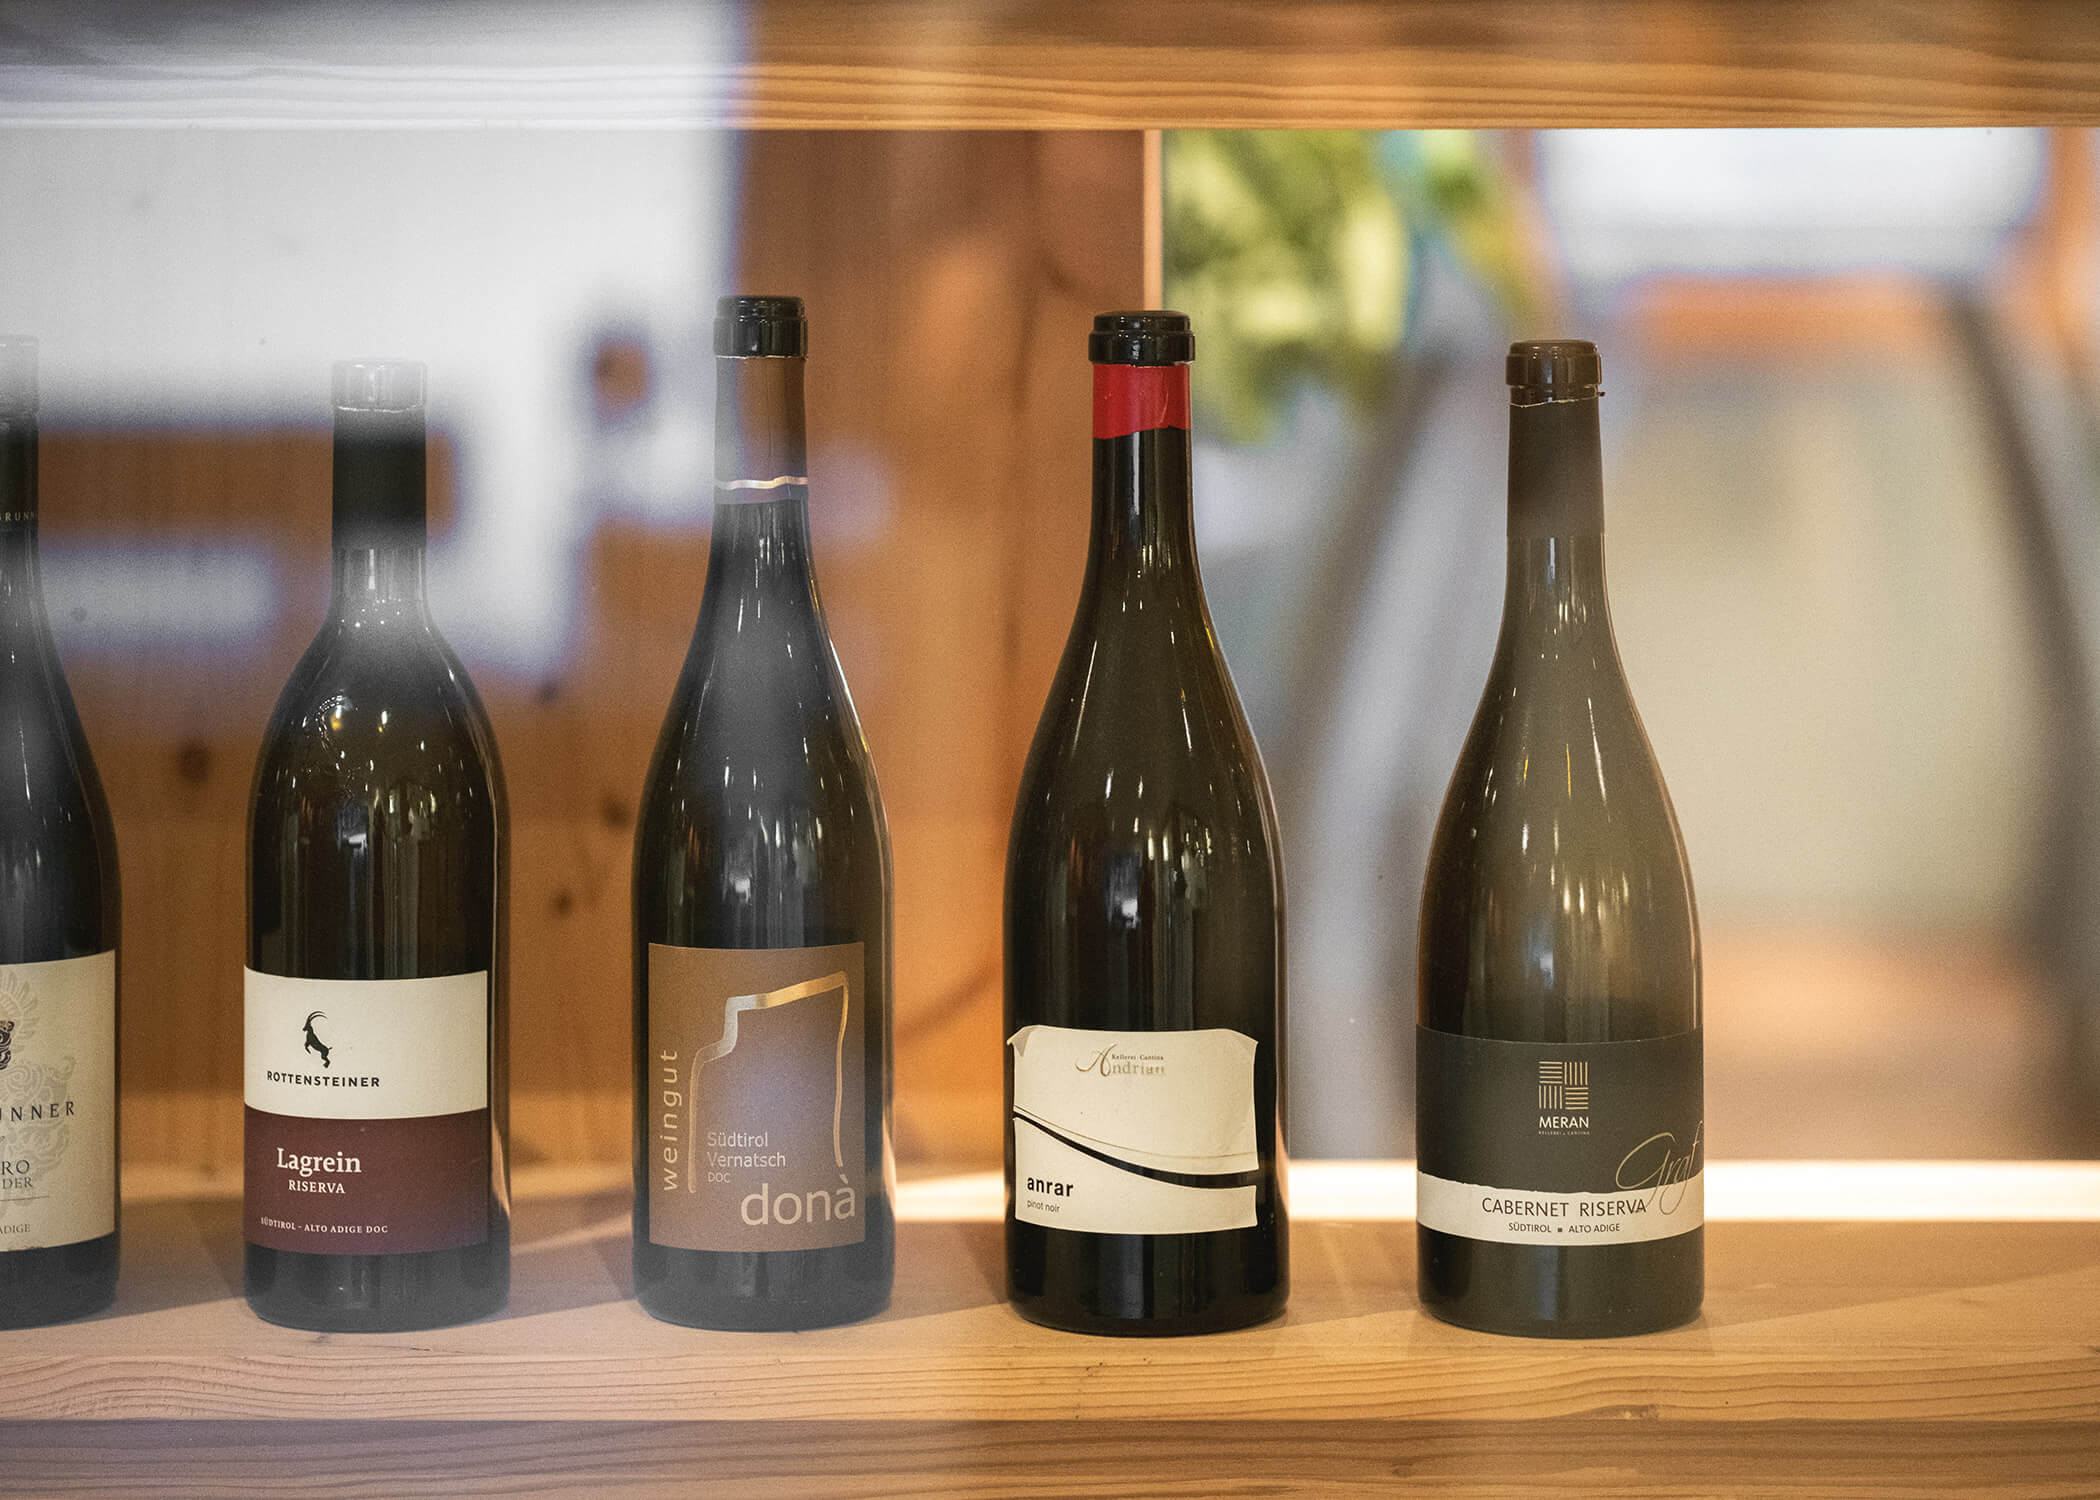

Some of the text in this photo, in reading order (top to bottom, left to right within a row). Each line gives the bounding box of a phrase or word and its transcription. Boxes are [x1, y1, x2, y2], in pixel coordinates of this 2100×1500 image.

[267, 1070, 380, 1087] ROTTENSTEINER
[660, 1050, 682, 1191] weingut
[1539, 1116, 1589, 1128] MERAN
[707, 1132, 768, 1147] Südtirol
[277, 1147, 362, 1177] Lagrein
[707, 1152, 786, 1168] Vernatsch
[707, 1172, 731, 1183] DOC
[288, 1180, 345, 1194] RISERVA
[1027, 1177, 1074, 1197] anrar
[740, 1174, 856, 1225] donà
[1027, 1200, 1060, 1213] pinot noir
[1482, 1198, 1647, 1217] CABERNET RISERVA
[261, 1217, 296, 1230] SÜDTIROL
[304, 1224, 328, 1233] ALTO
[1508, 1222, 1620, 1233] SÜDTIROL ALTO ADIGE
